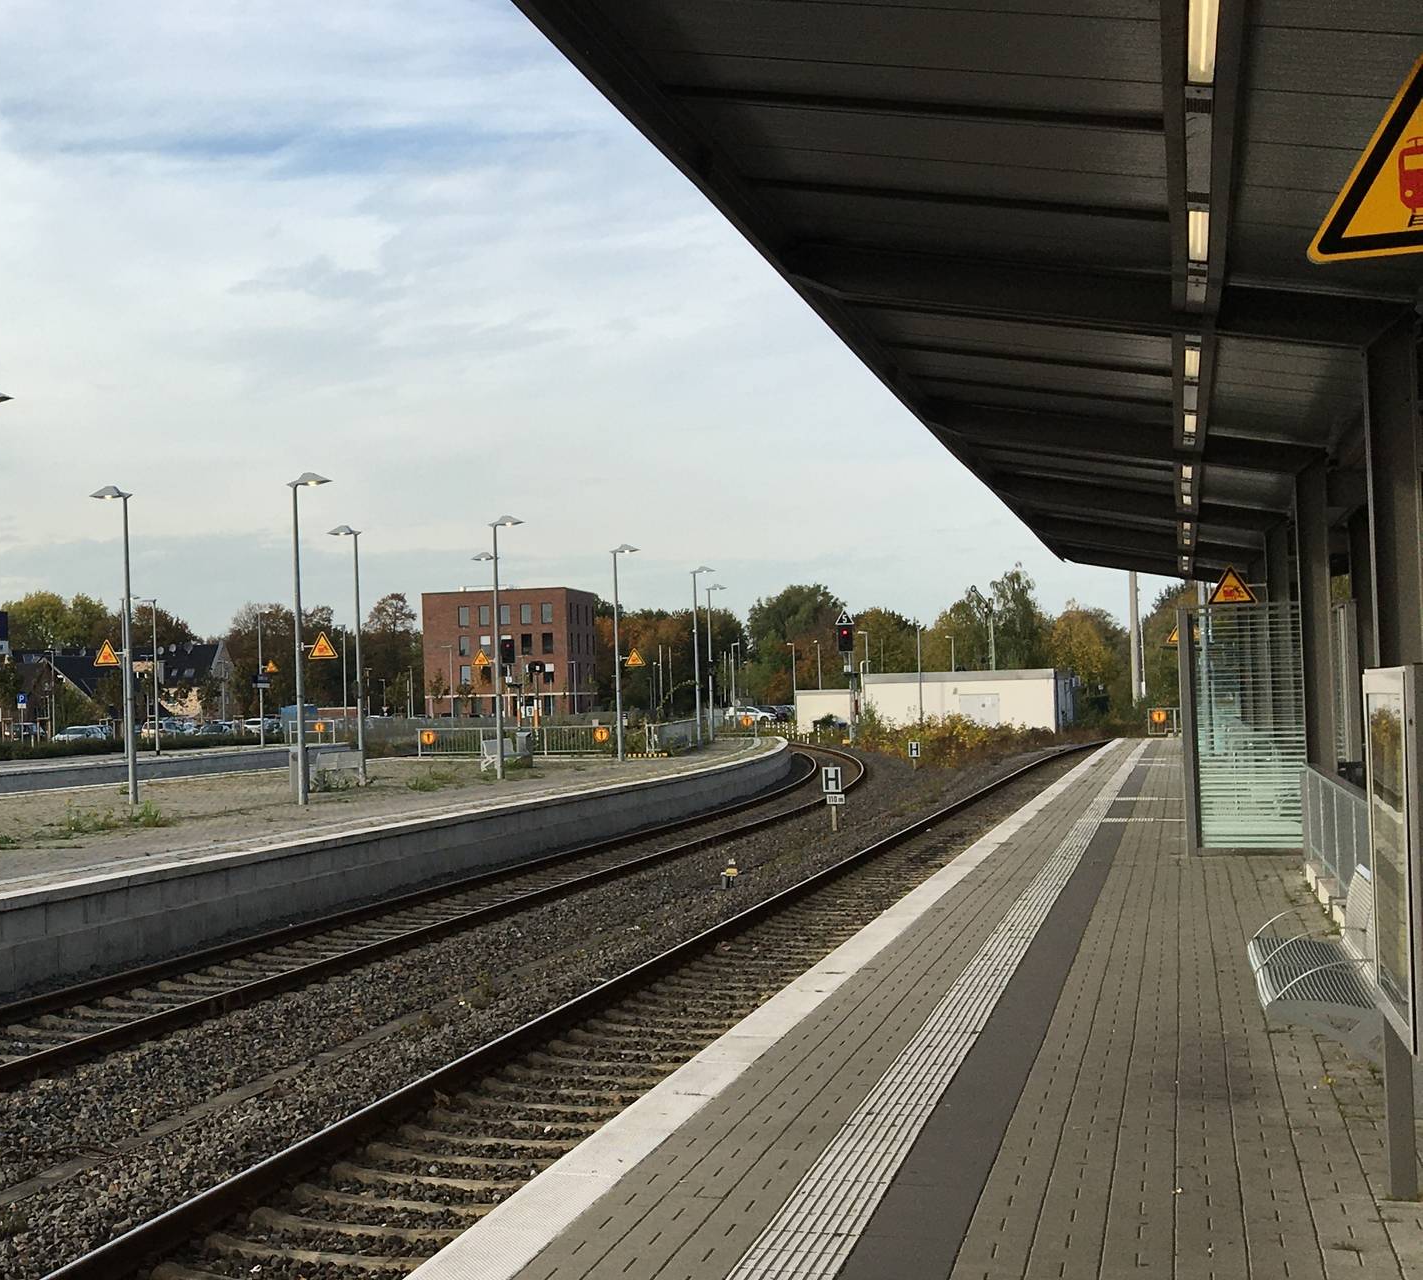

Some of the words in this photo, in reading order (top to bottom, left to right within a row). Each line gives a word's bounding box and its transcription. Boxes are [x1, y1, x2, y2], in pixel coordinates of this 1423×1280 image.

[842, 614, 848, 623] 5
[909, 742, 919, 756] H
[824, 768, 839, 791] H
